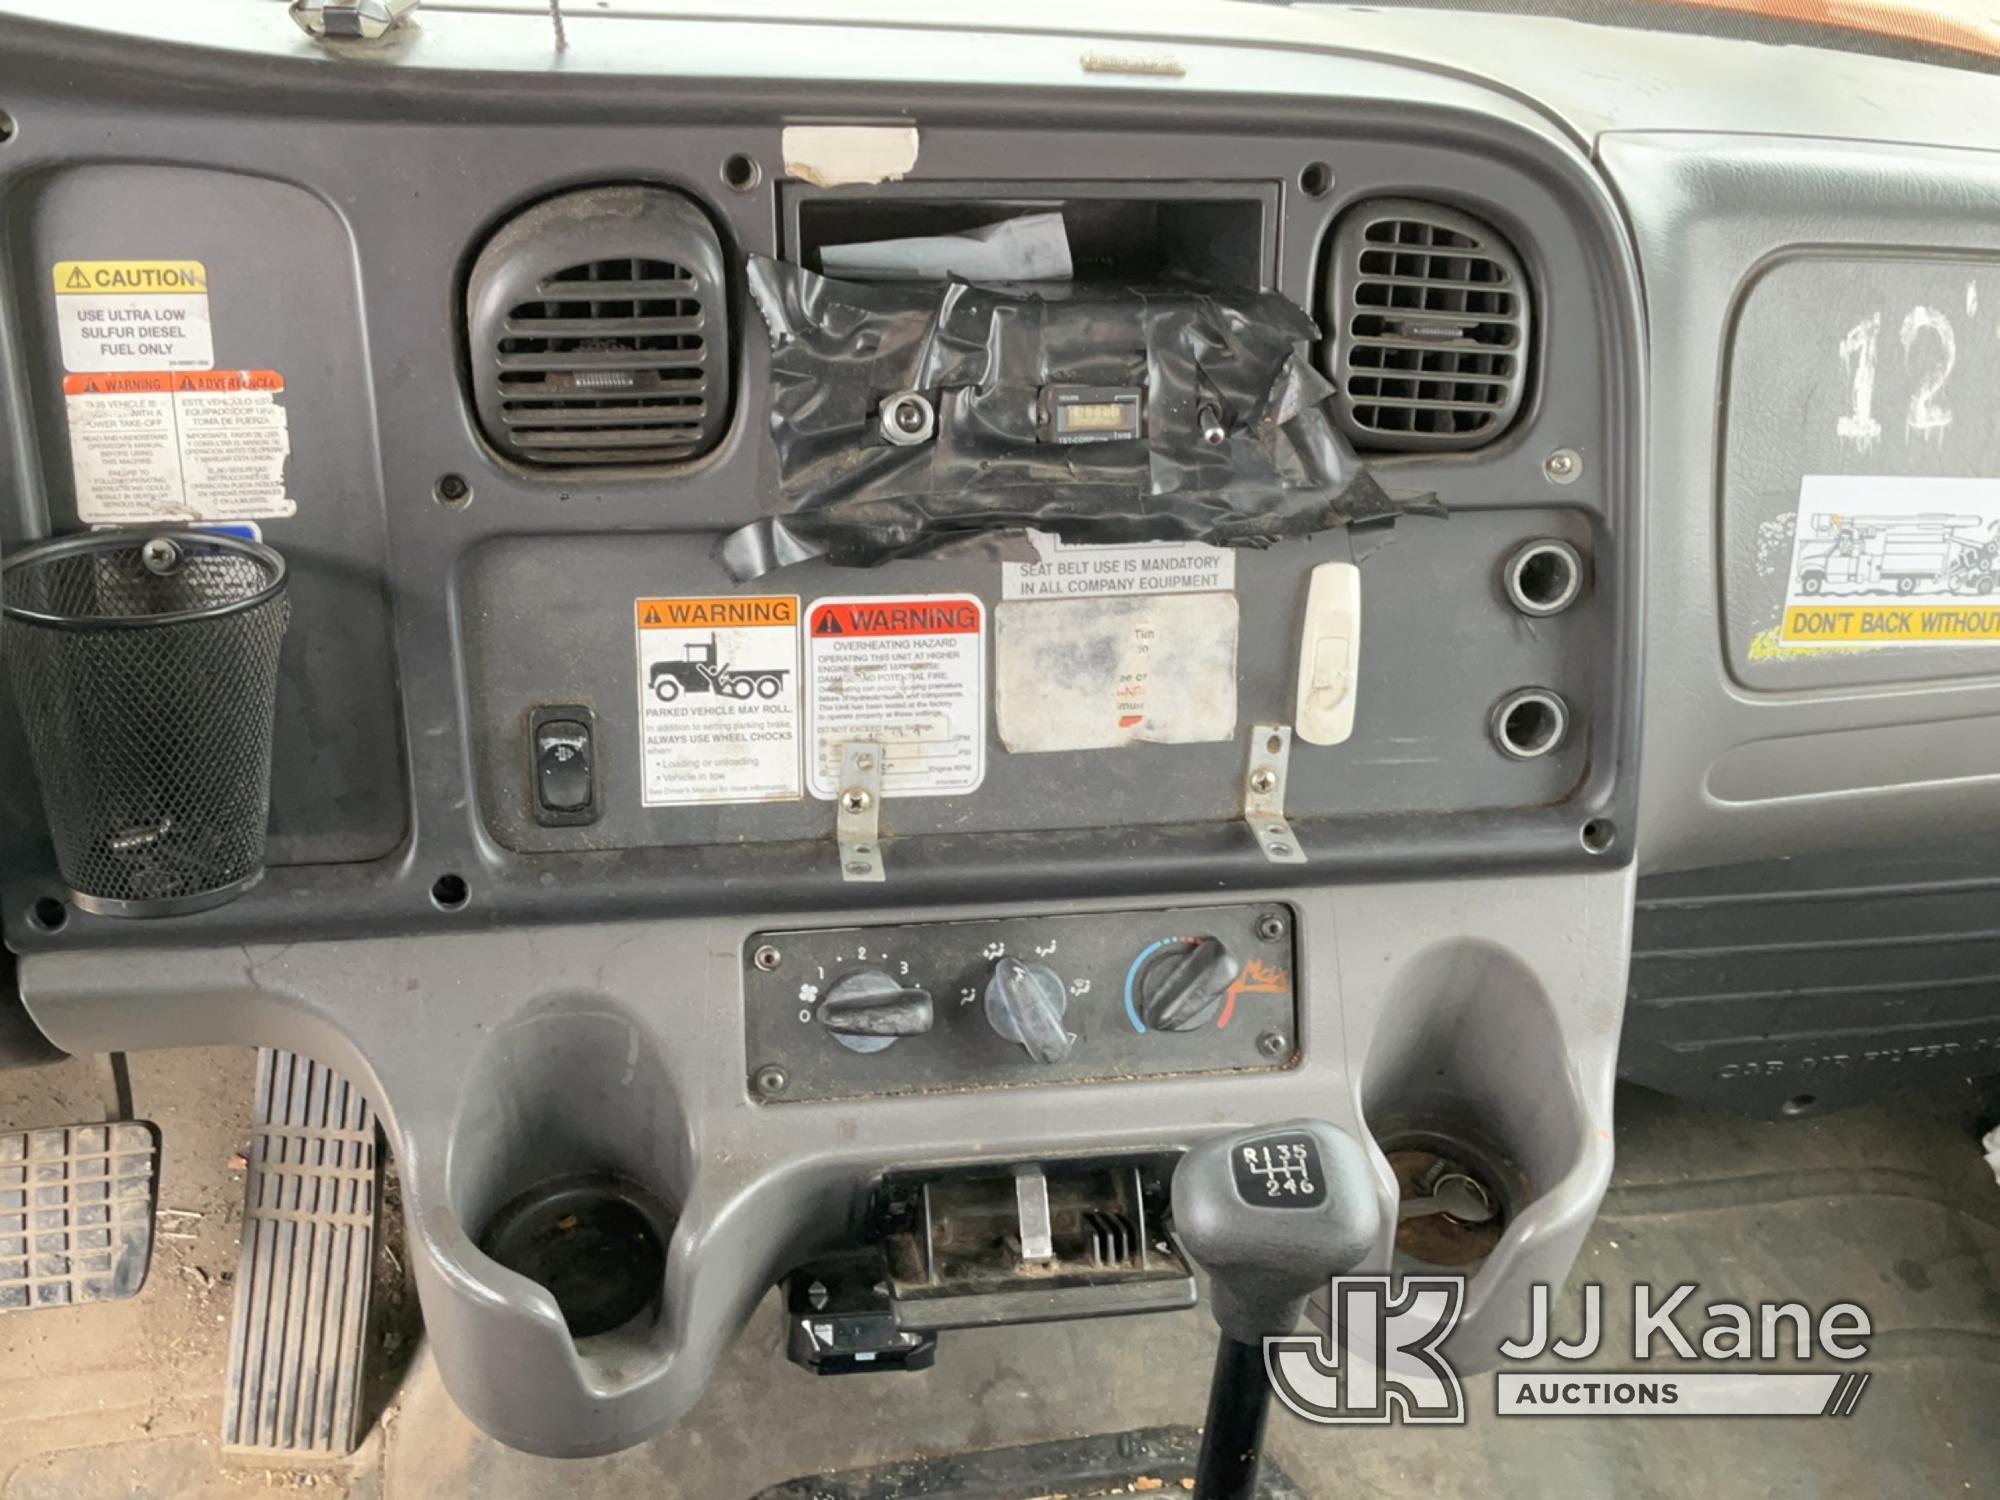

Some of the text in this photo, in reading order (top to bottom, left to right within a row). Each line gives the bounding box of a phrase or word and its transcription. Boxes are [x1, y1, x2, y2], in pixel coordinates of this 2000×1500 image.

[95, 269, 195, 287] CAUTION
[77, 309, 186, 322] USE ULTRA LOW
[81, 326, 186, 339] SULFUR DIESEL
[100, 344, 174, 356] FUEL ONLY
[105, 379, 161, 391] WARNING
[1020, 556, 1221, 577] SEAT BELT USE IS MANDATORY
[1021, 574, 1219, 595] IN ALL COMPANY EQUIPMENT
[668, 602, 790, 623] WARNING
[849, 607, 975, 632] WARNING
[1793, 612, 1854, 634] DON'T
[1860, 612, 1914, 633] BACK
[833, 638, 957, 651] OVERHEATING HAZARD
[818, 653, 868, 663] OPERATING
[871, 652, 890, 662] THIS
[892, 652, 912, 661] UNIT
[926, 651, 960, 659] HIGHER
[818, 664, 853, 673] ENGINE
[646, 704, 793, 717] PARKED VEHICLE MAY ROLL.
[656, 723, 690, 732] addition
[703, 722, 732, 732] setting
[734, 722, 764, 732] parking
[647, 732, 793, 744] ALWAYS USE WHEEL CHOCKS
[662, 759, 700, 769] Loading
[714, 758, 760, 768] unloading
[662, 774, 696, 782] Vehicle
[857, 946, 867, 960] 2
[818, 966, 825, 980] 1
[900, 961, 909, 975] 3
[1243, 1147, 1258, 1164] R
[1276, 1144, 1291, 1160] 3
[1292, 1144, 1307, 1160] 5
[1266, 1178, 1314, 1196] 2 4 6
